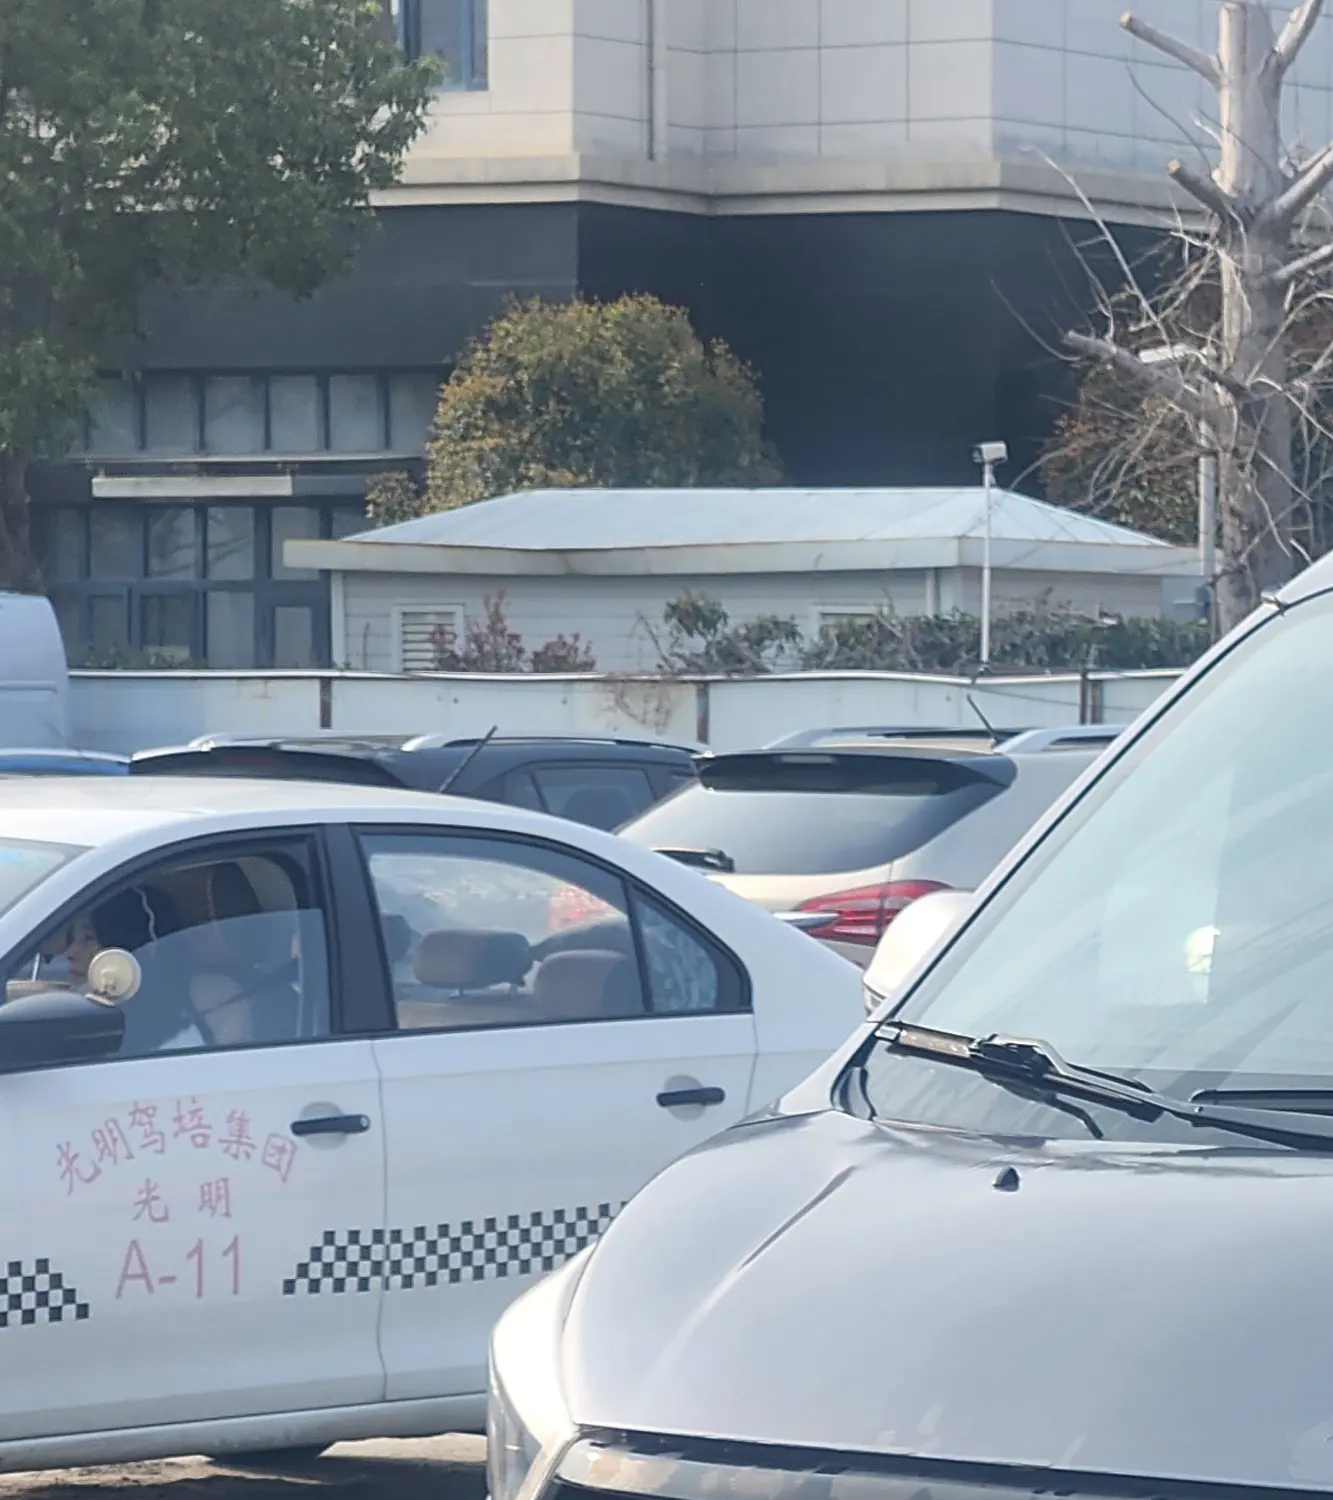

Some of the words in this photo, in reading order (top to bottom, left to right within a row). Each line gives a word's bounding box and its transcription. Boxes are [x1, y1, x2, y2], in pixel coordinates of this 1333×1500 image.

[57, 1097, 298, 1196] 光明驾培集团
[115, 1234, 240, 1299] A-11
